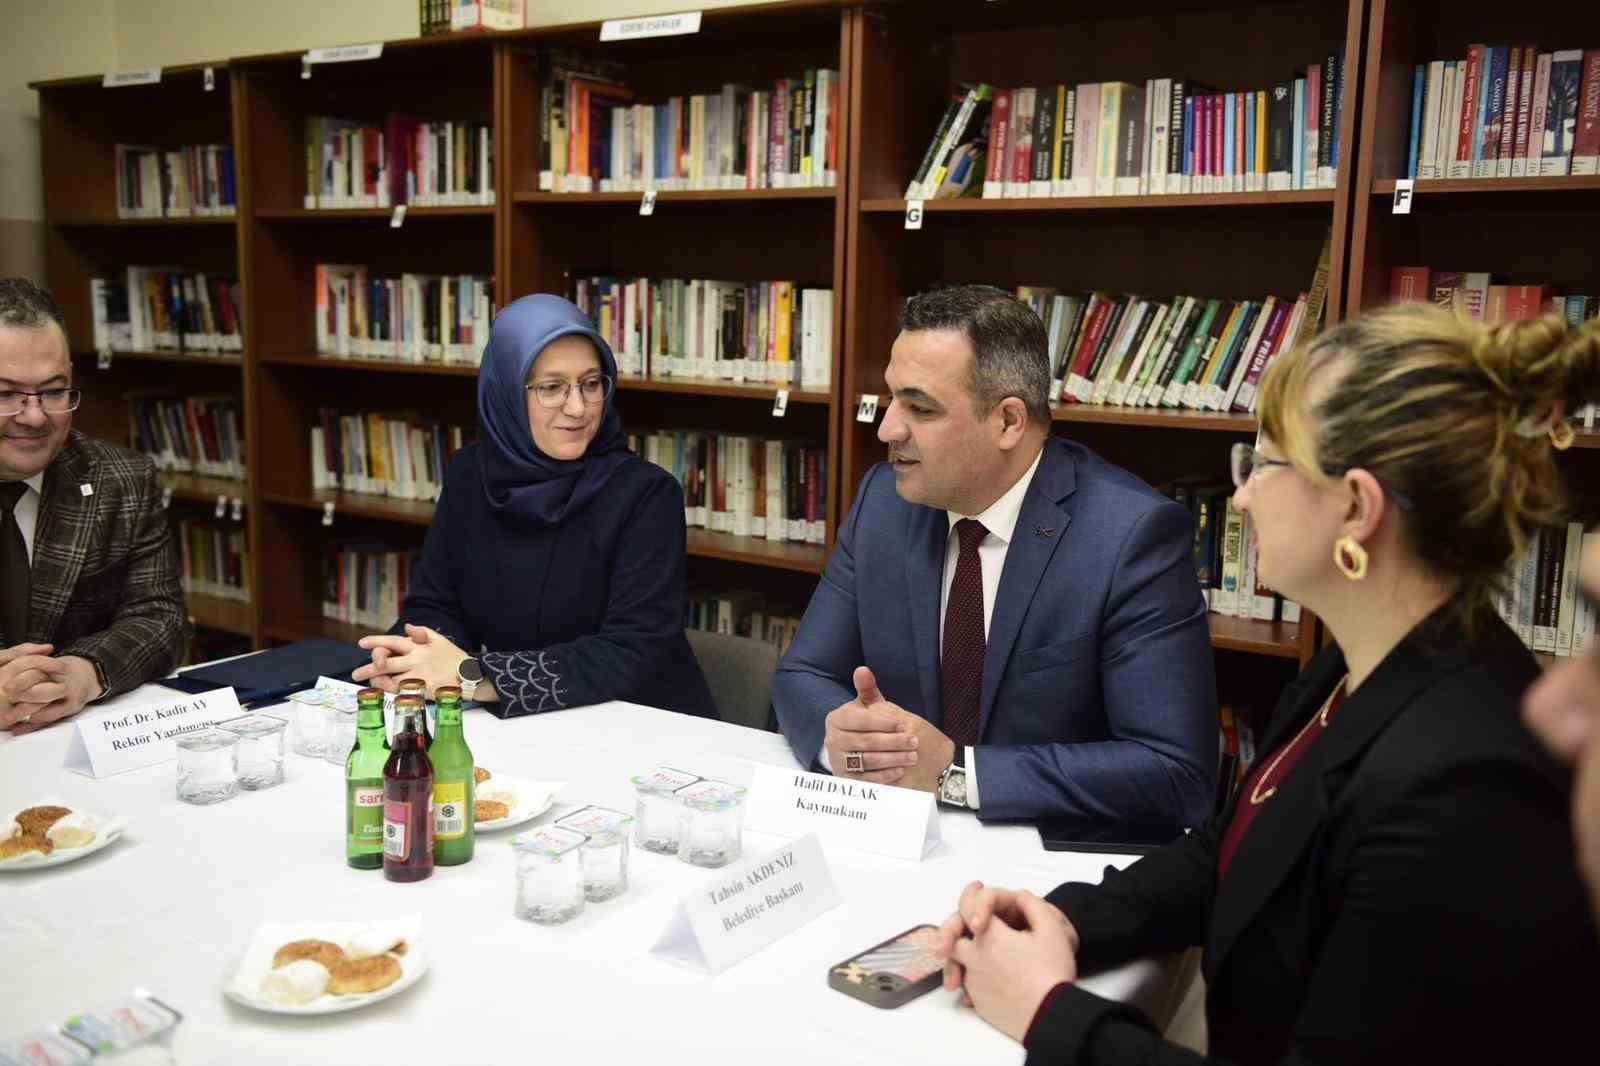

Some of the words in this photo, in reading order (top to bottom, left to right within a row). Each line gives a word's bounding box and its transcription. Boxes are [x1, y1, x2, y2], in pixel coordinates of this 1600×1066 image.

[1395, 189, 1410, 206] F
[907, 208, 920, 223] G
[1250, 340, 1271, 372] FRIDA
[775, 397, 784, 410] L
[860, 402, 875, 416] M
[103, 716, 131, 731] Prof.
[135, 711, 154, 725] Dr.
[155, 702, 189, 721] Kadir
[191, 698, 208, 713] AY
[112, 734, 152, 751] Rektör
[794, 775, 824, 792] Halil
[827, 782, 880, 801] DALAK
[796, 797, 868, 821] Kaymakam
